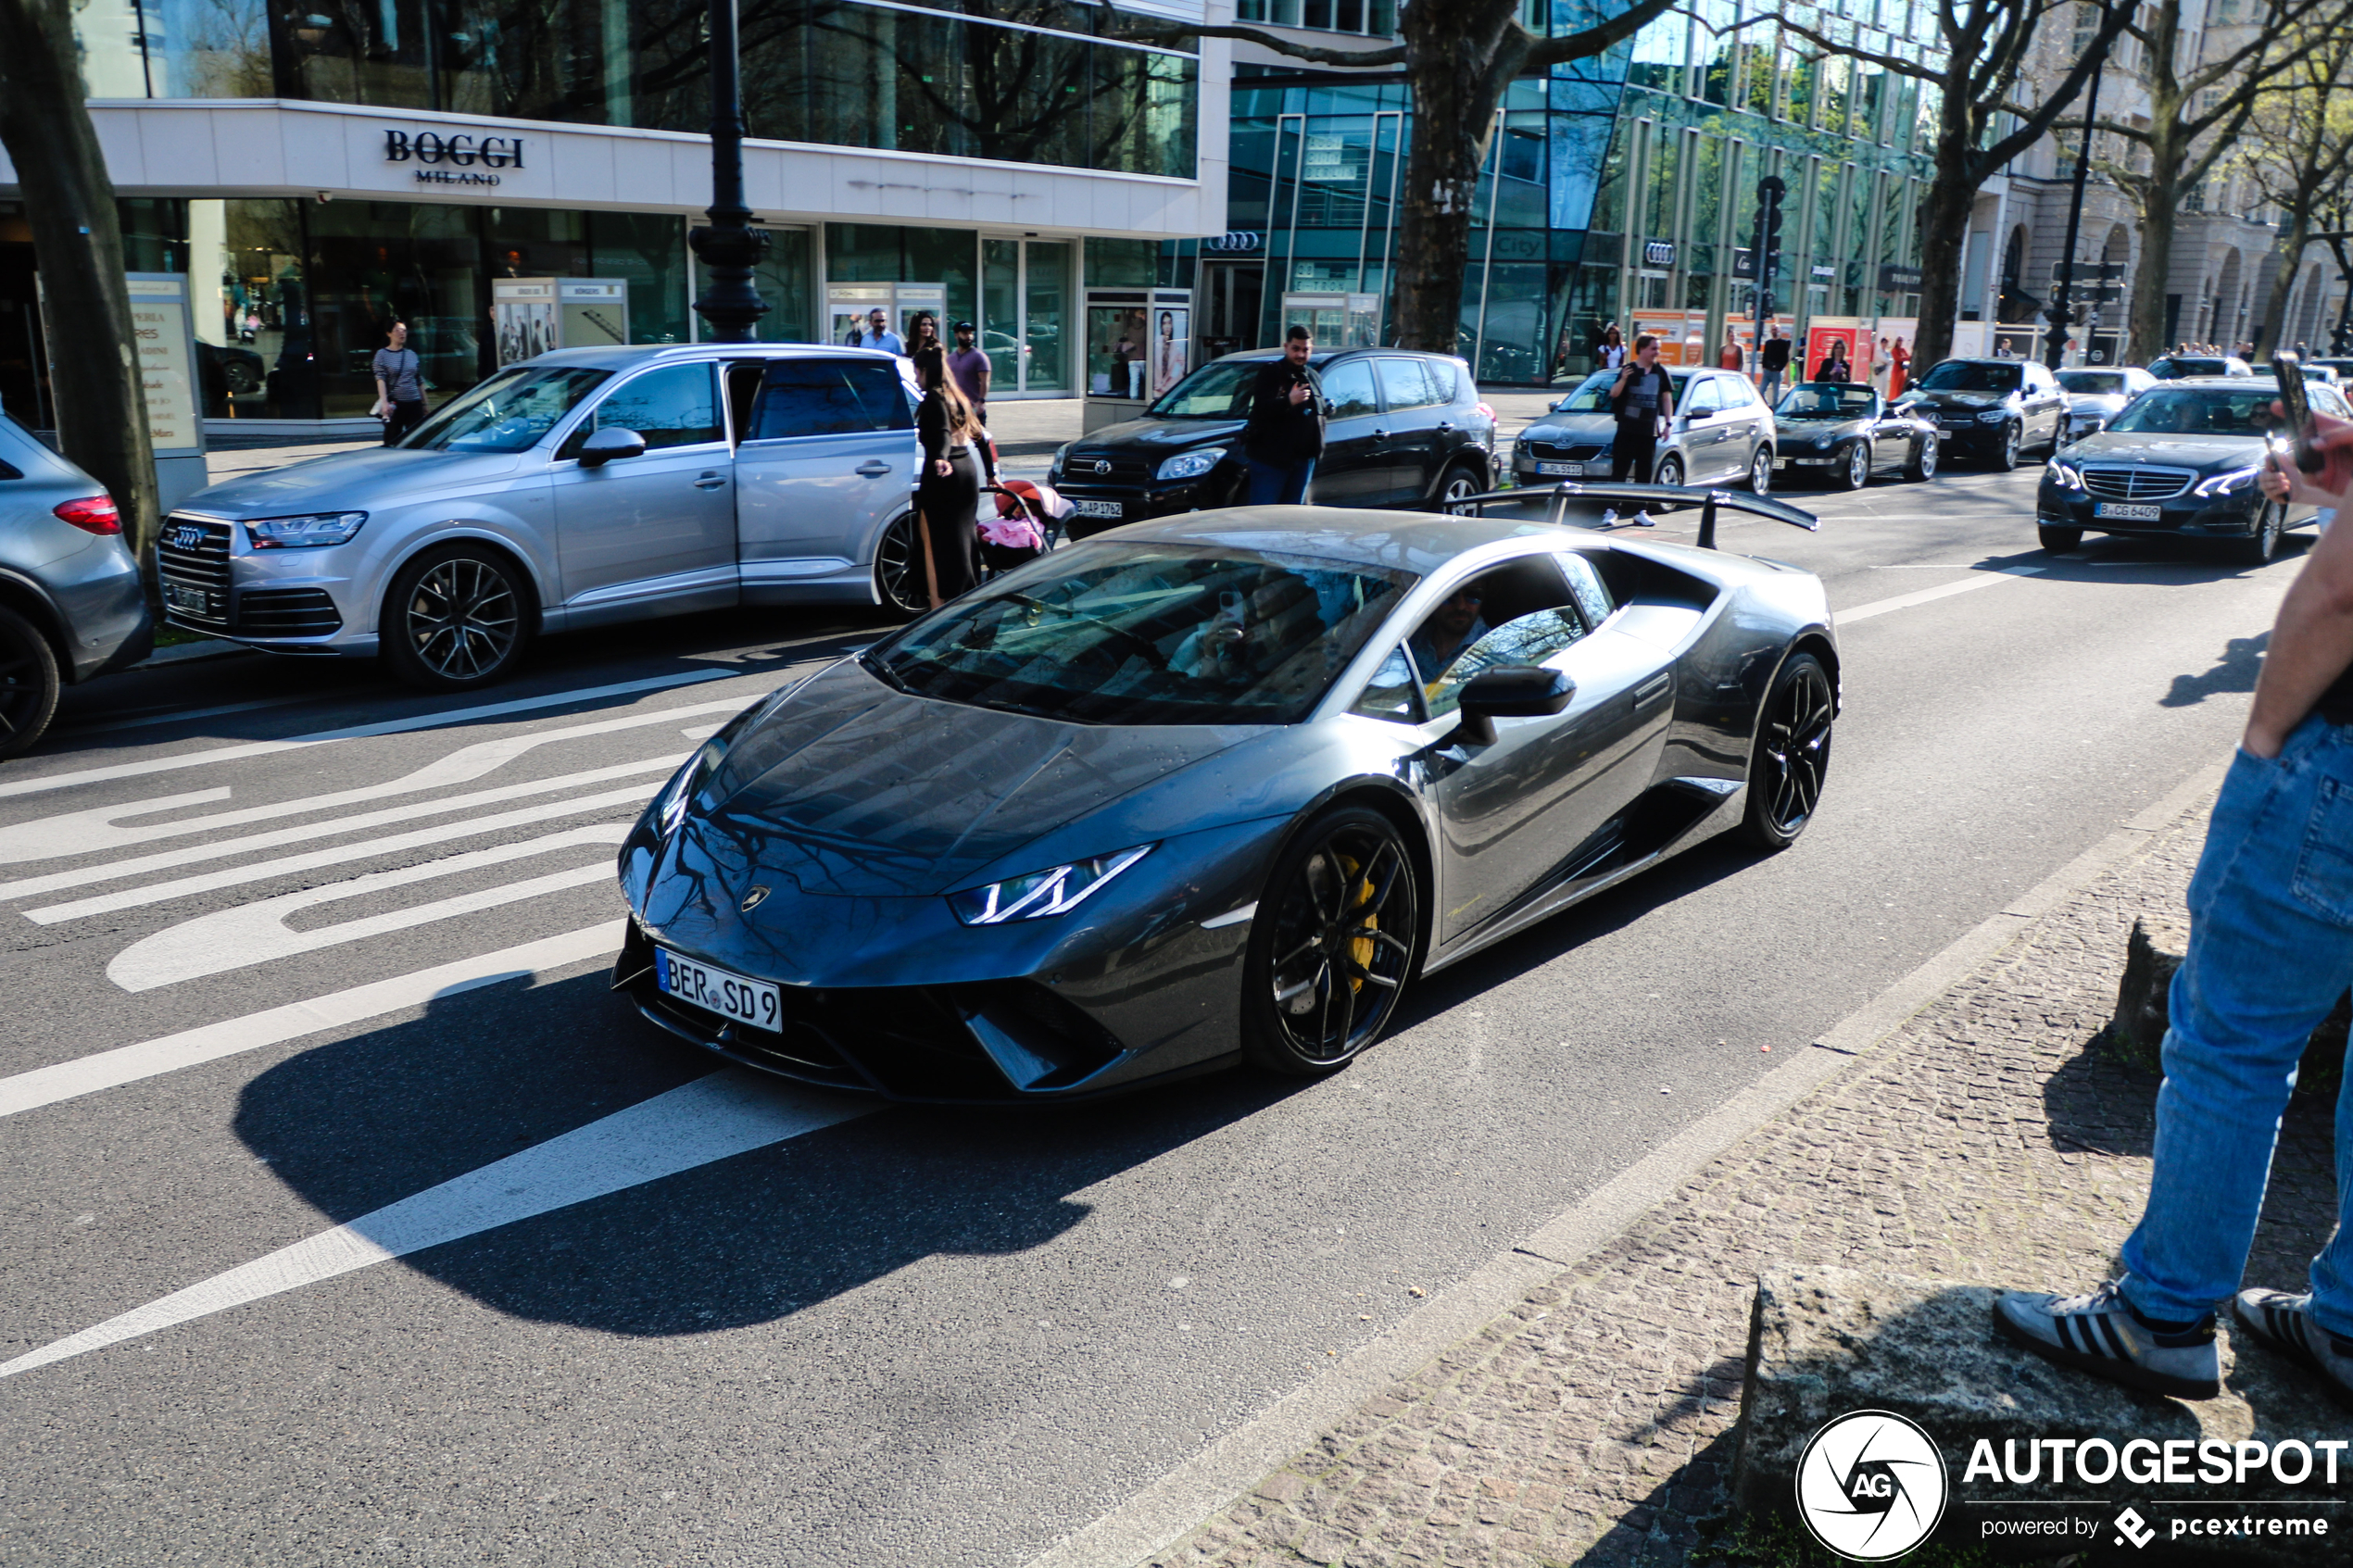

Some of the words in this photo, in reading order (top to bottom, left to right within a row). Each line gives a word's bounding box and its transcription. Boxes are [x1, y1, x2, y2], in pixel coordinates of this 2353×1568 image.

[384, 130, 525, 169] BOGGI
[414, 169, 501, 186] MILANO
[1496, 236, 1541, 257] City
[1077, 501, 1083, 512] B
[1088, 502, 1099, 514] AP
[1101, 503, 1121, 516] 1762
[2101, 504, 2108, 515] B
[2115, 506, 2129, 516] CG
[2131, 507, 2158, 518] 6409
[666, 958, 709, 1005] BER
[724, 980, 755, 1020] SD
[761, 991, 777, 1025] 9
